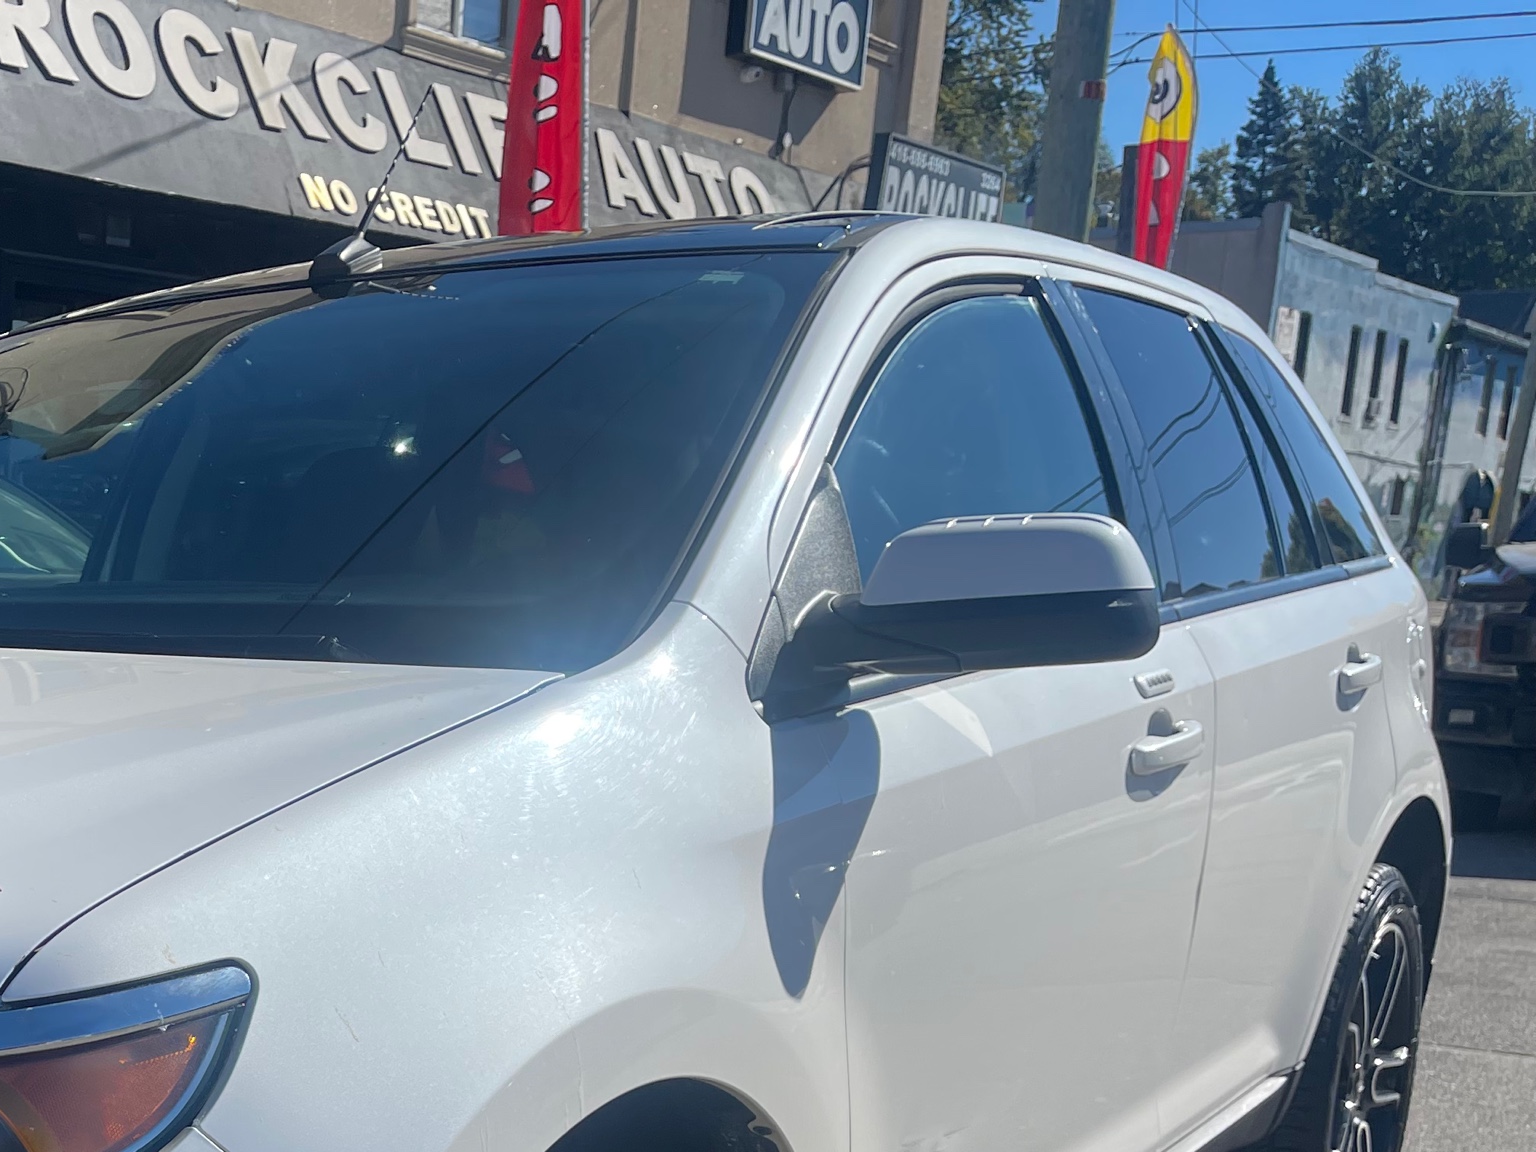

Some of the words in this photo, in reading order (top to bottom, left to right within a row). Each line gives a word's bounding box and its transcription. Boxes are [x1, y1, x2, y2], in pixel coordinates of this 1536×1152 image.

[758, 0, 860, 74] AUTO
[300, 173, 357, 215] NO
[367, 187, 491, 239] CREDIT
